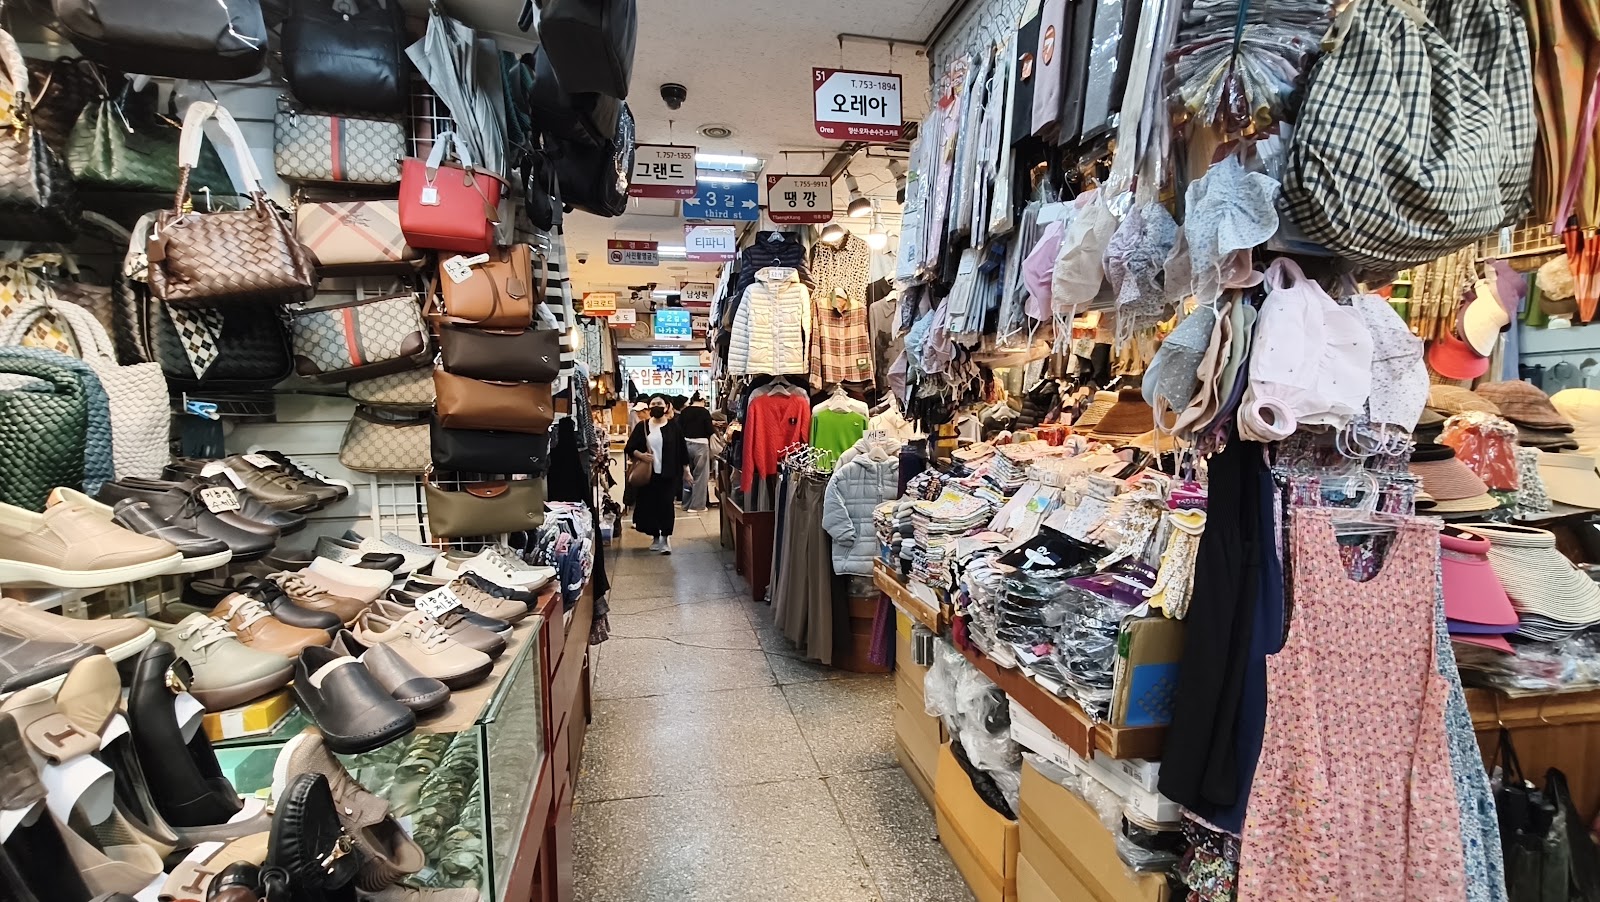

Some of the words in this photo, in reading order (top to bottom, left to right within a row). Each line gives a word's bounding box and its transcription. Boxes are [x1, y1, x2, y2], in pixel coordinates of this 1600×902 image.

[815, 70, 826, 81] 51
[851, 80, 897, 91] T.753-1894
[831, 94, 888, 117] 오레아
[820, 126, 834, 134] Orea
[656, 151, 692, 160] T.757-1355
[636, 163, 684, 180] 그랜드
[769, 176, 777, 184] 43
[706, 191, 717, 206] 3
[724, 195, 735, 208] 길
[705, 208, 729, 219] third
[733, 211, 743, 219] st
[695, 237, 726, 249] 티파니
[686, 290, 709, 300] 남성복
